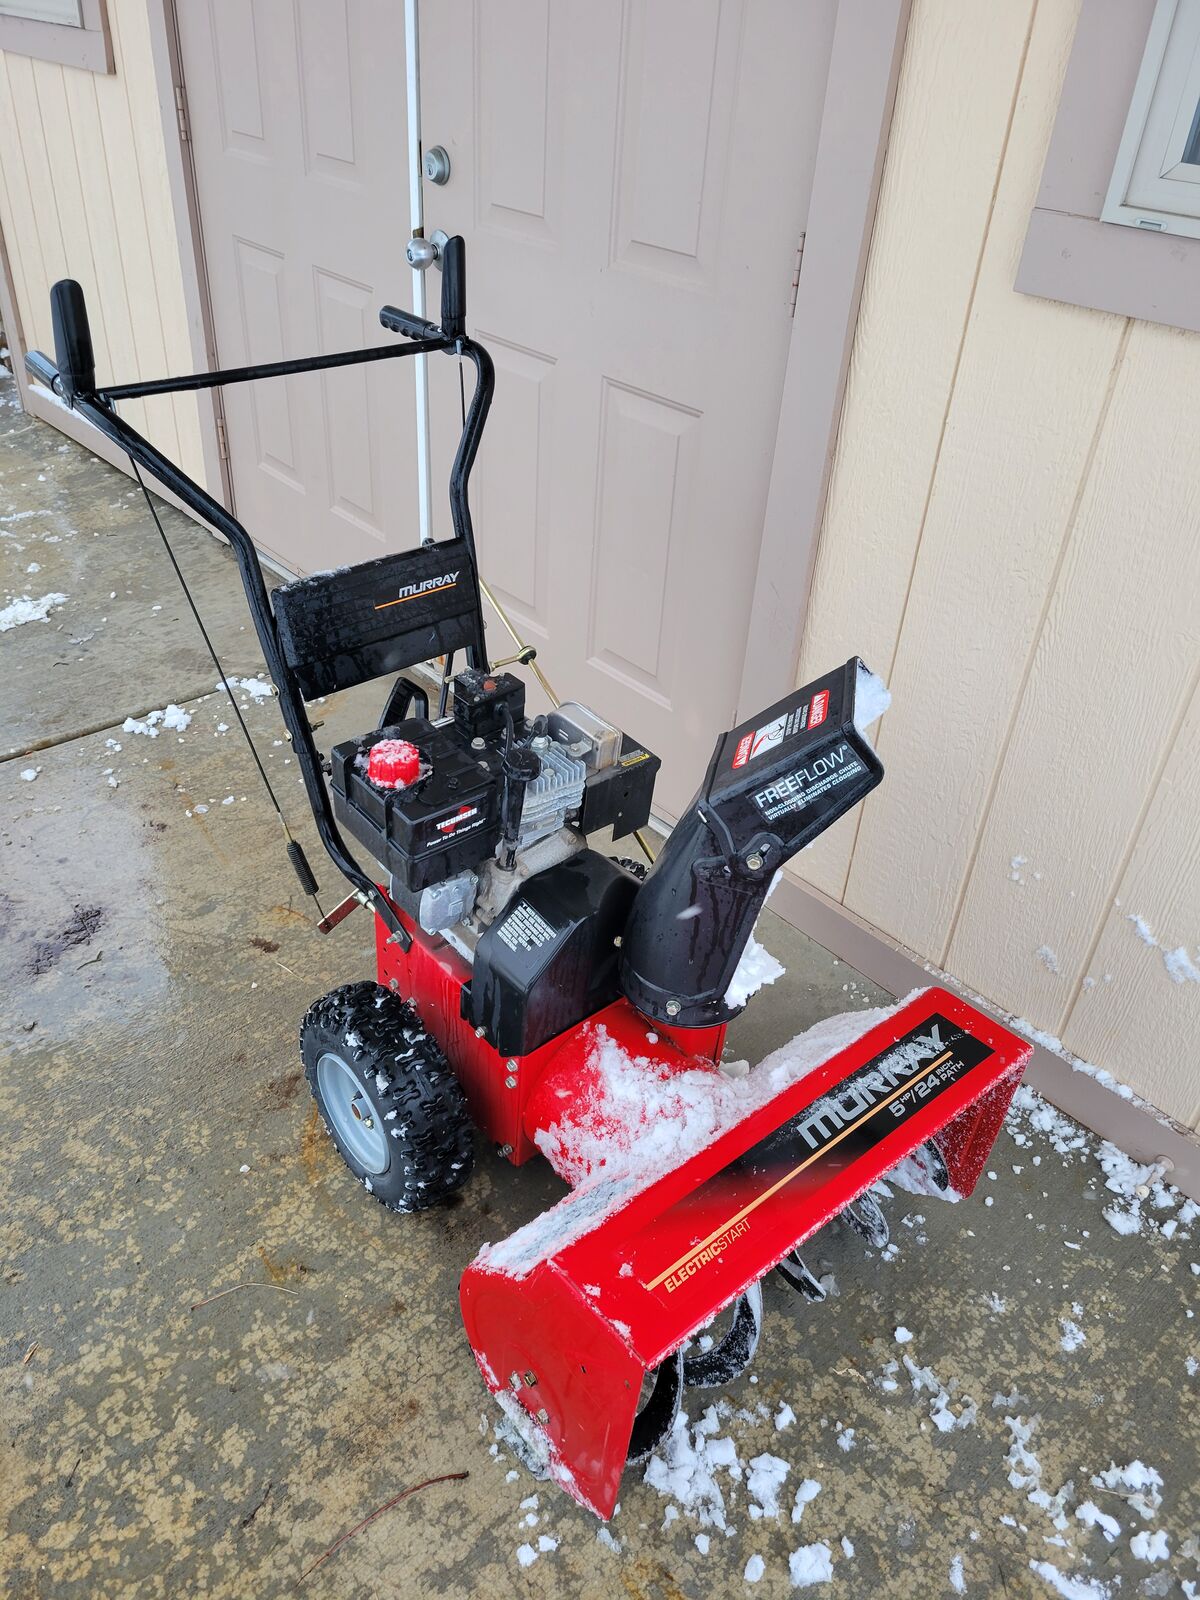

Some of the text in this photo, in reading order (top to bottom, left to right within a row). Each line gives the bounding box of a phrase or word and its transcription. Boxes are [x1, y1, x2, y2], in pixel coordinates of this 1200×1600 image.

[399, 571, 460, 599] MURRAY
[767, 765, 862, 820] VIRTUALLY ELIMINATES CLOGGING
[806, 773, 839, 794] DISCHARGE
[838, 761, 859, 775] CHUTE
[935, 1060, 954, 1076] INCH
[939, 1060, 965, 1081] PATH
[796, 1023, 947, 1149] MURRAY
